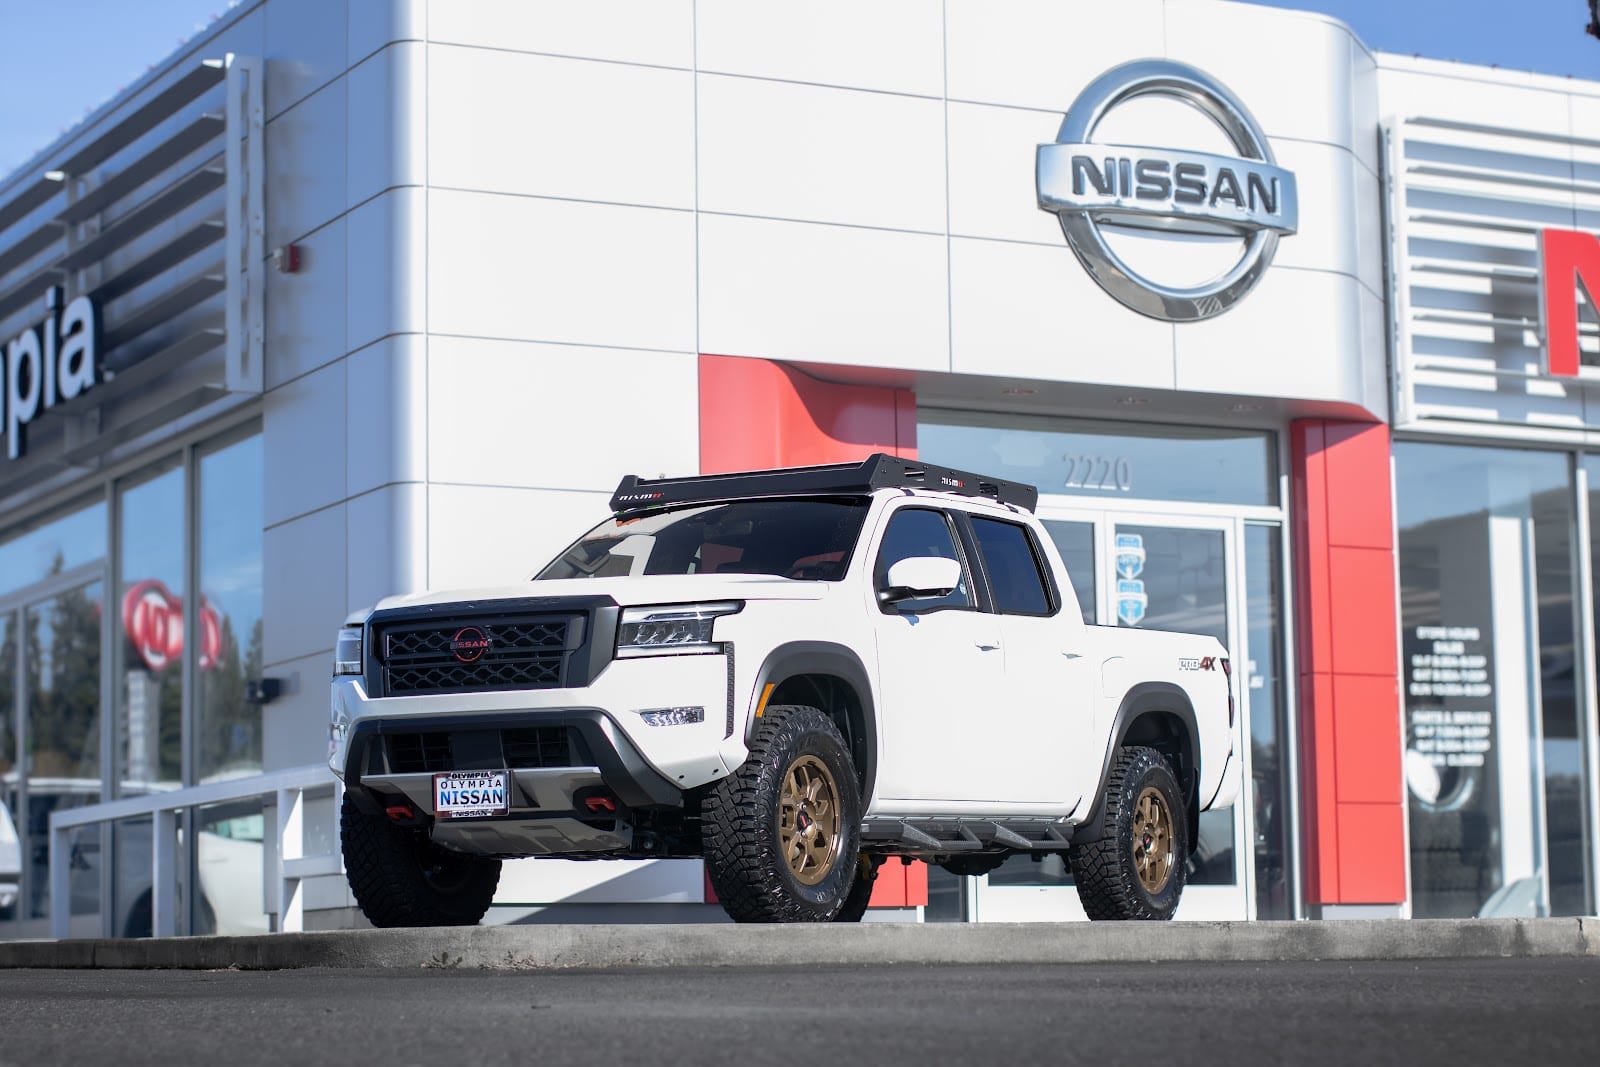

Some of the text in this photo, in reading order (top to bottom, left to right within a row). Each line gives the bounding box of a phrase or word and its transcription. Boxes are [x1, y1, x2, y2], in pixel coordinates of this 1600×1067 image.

[1071, 155, 1281, 217] NISSAN
[0, 286, 95, 460] pia
[1062, 452, 1132, 492] 2220
[440, 780, 502, 789] OLYMPIA
[440, 789, 504, 806] NISSAN
